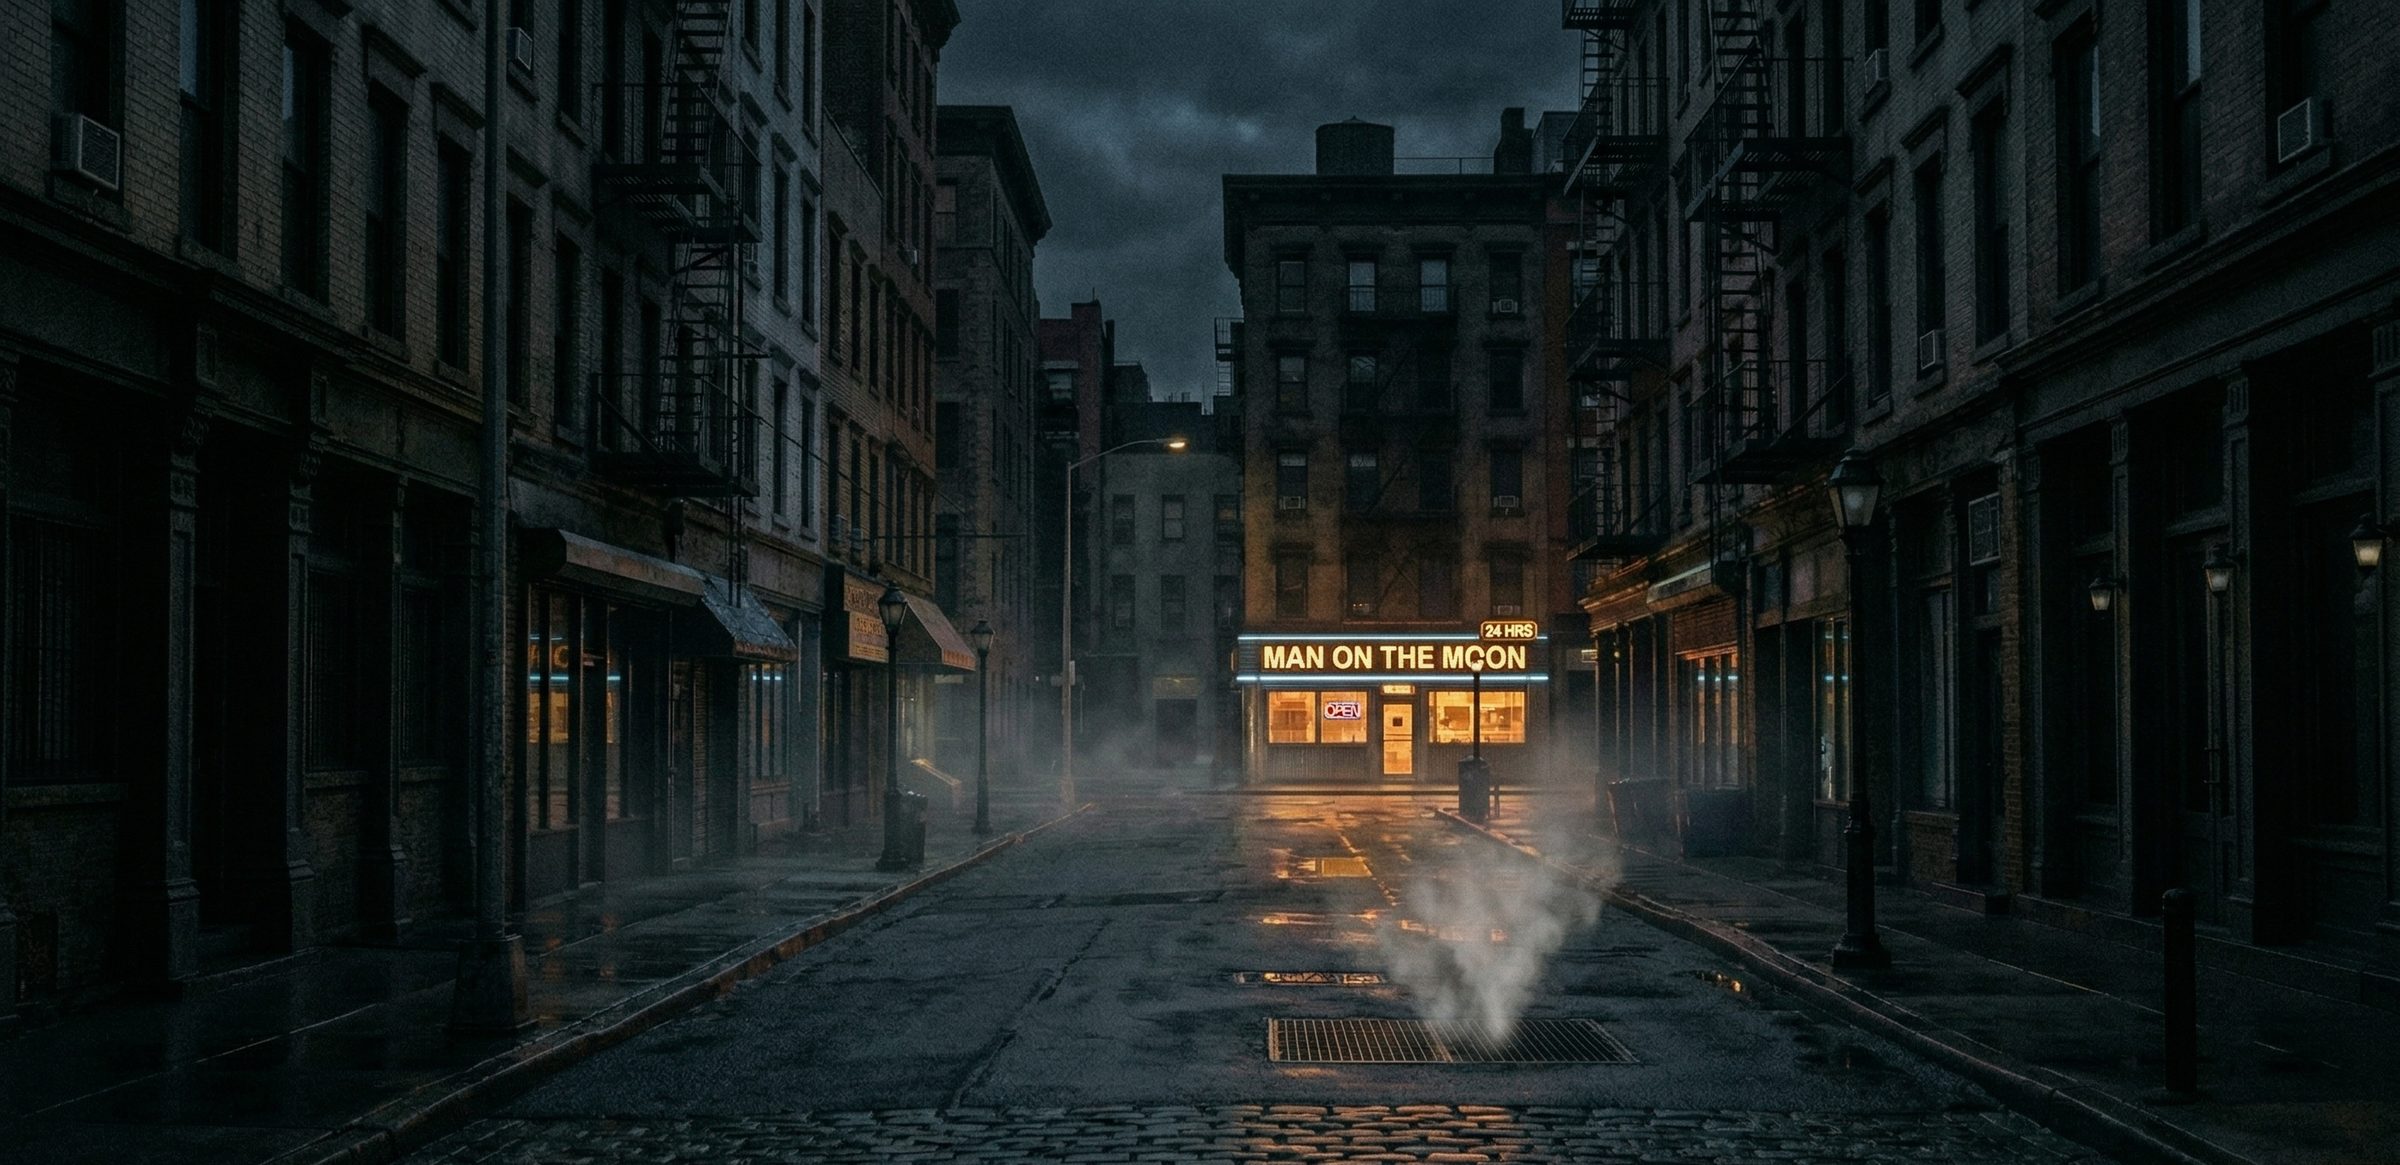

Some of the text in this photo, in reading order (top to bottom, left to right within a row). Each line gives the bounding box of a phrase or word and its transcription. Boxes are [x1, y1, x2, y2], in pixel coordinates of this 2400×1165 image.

[1485, 624, 1533, 638] 24 HRS
[1263, 645, 1526, 670] MAN ON THE MOON
[1325, 703, 1361, 718] OPEN
